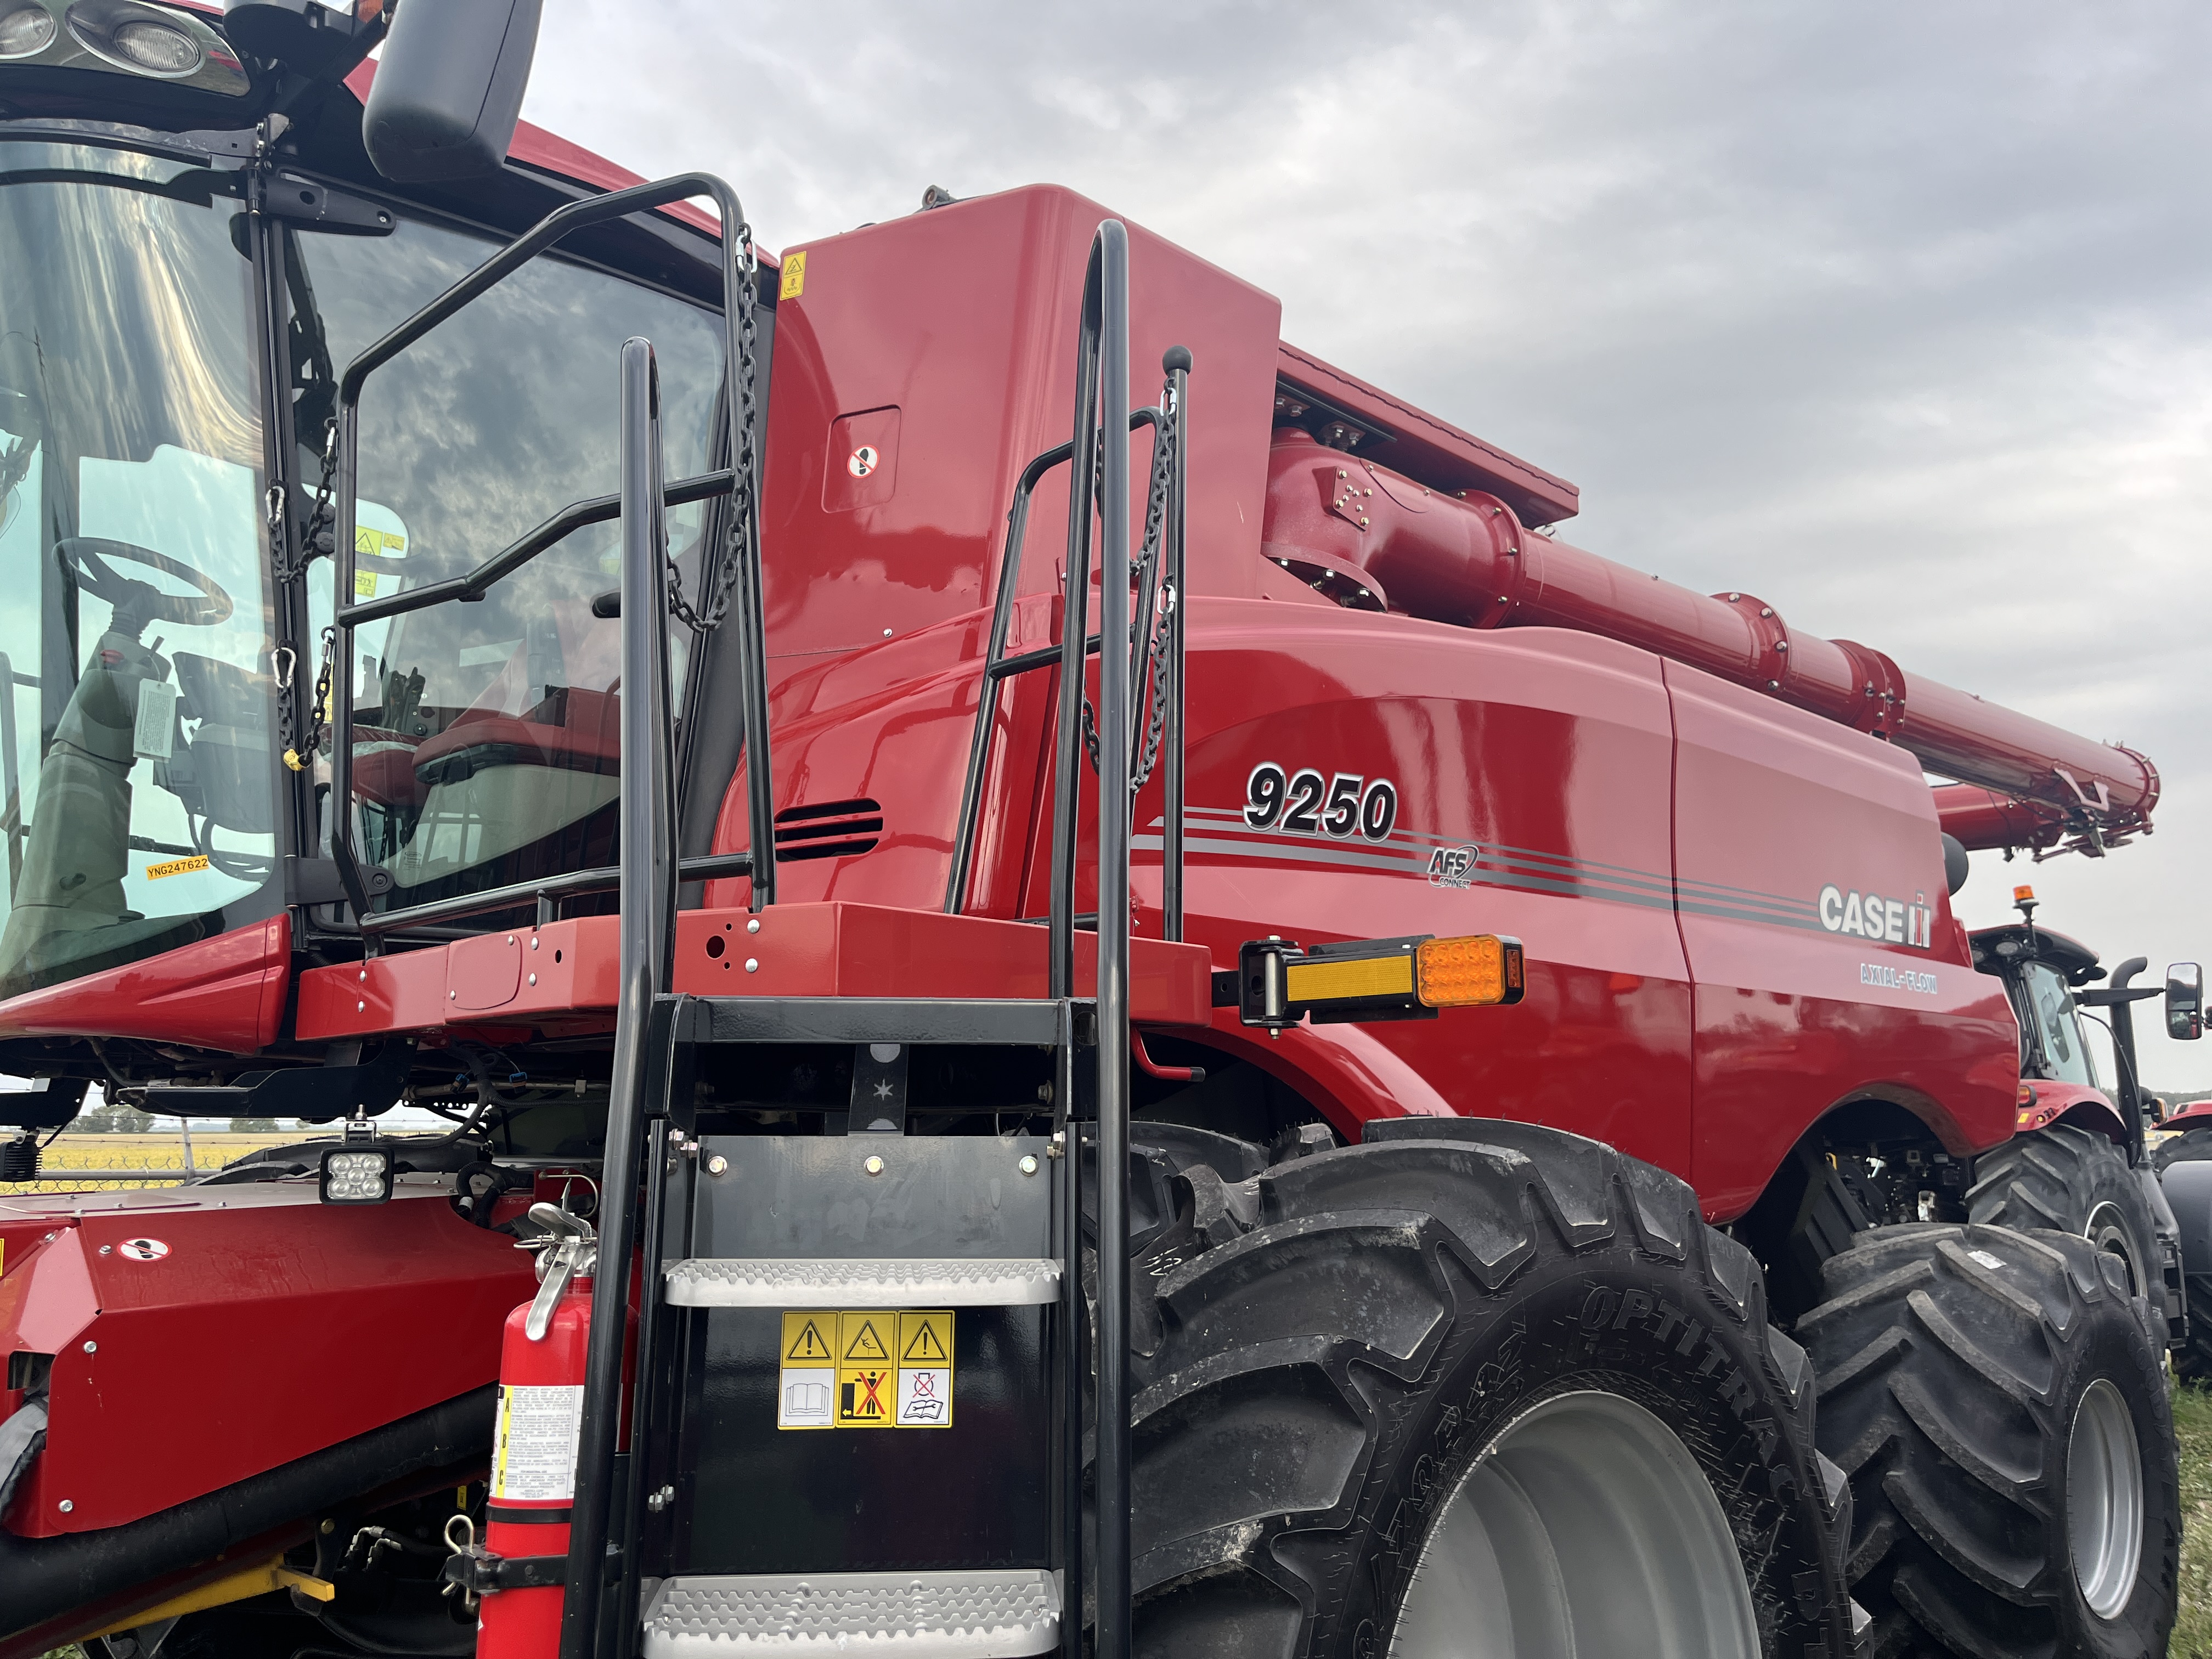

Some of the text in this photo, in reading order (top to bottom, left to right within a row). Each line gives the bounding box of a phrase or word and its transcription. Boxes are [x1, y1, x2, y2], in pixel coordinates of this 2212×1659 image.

[1243, 761, 1397, 843] 9250
[148, 858, 207, 877] YNG247622
[1429, 848, 1469, 876] AFS
[1440, 878, 1470, 888] CONNECT
[1819, 885, 1903, 943] CASE
[1860, 963, 1937, 995] AXIAL-FLOW
[505, 1397, 510, 1413] A
[1579, 1285, 1801, 1510] OPTITRAC
[502, 1433, 507, 1449] B
[499, 1470, 504, 1486] C
